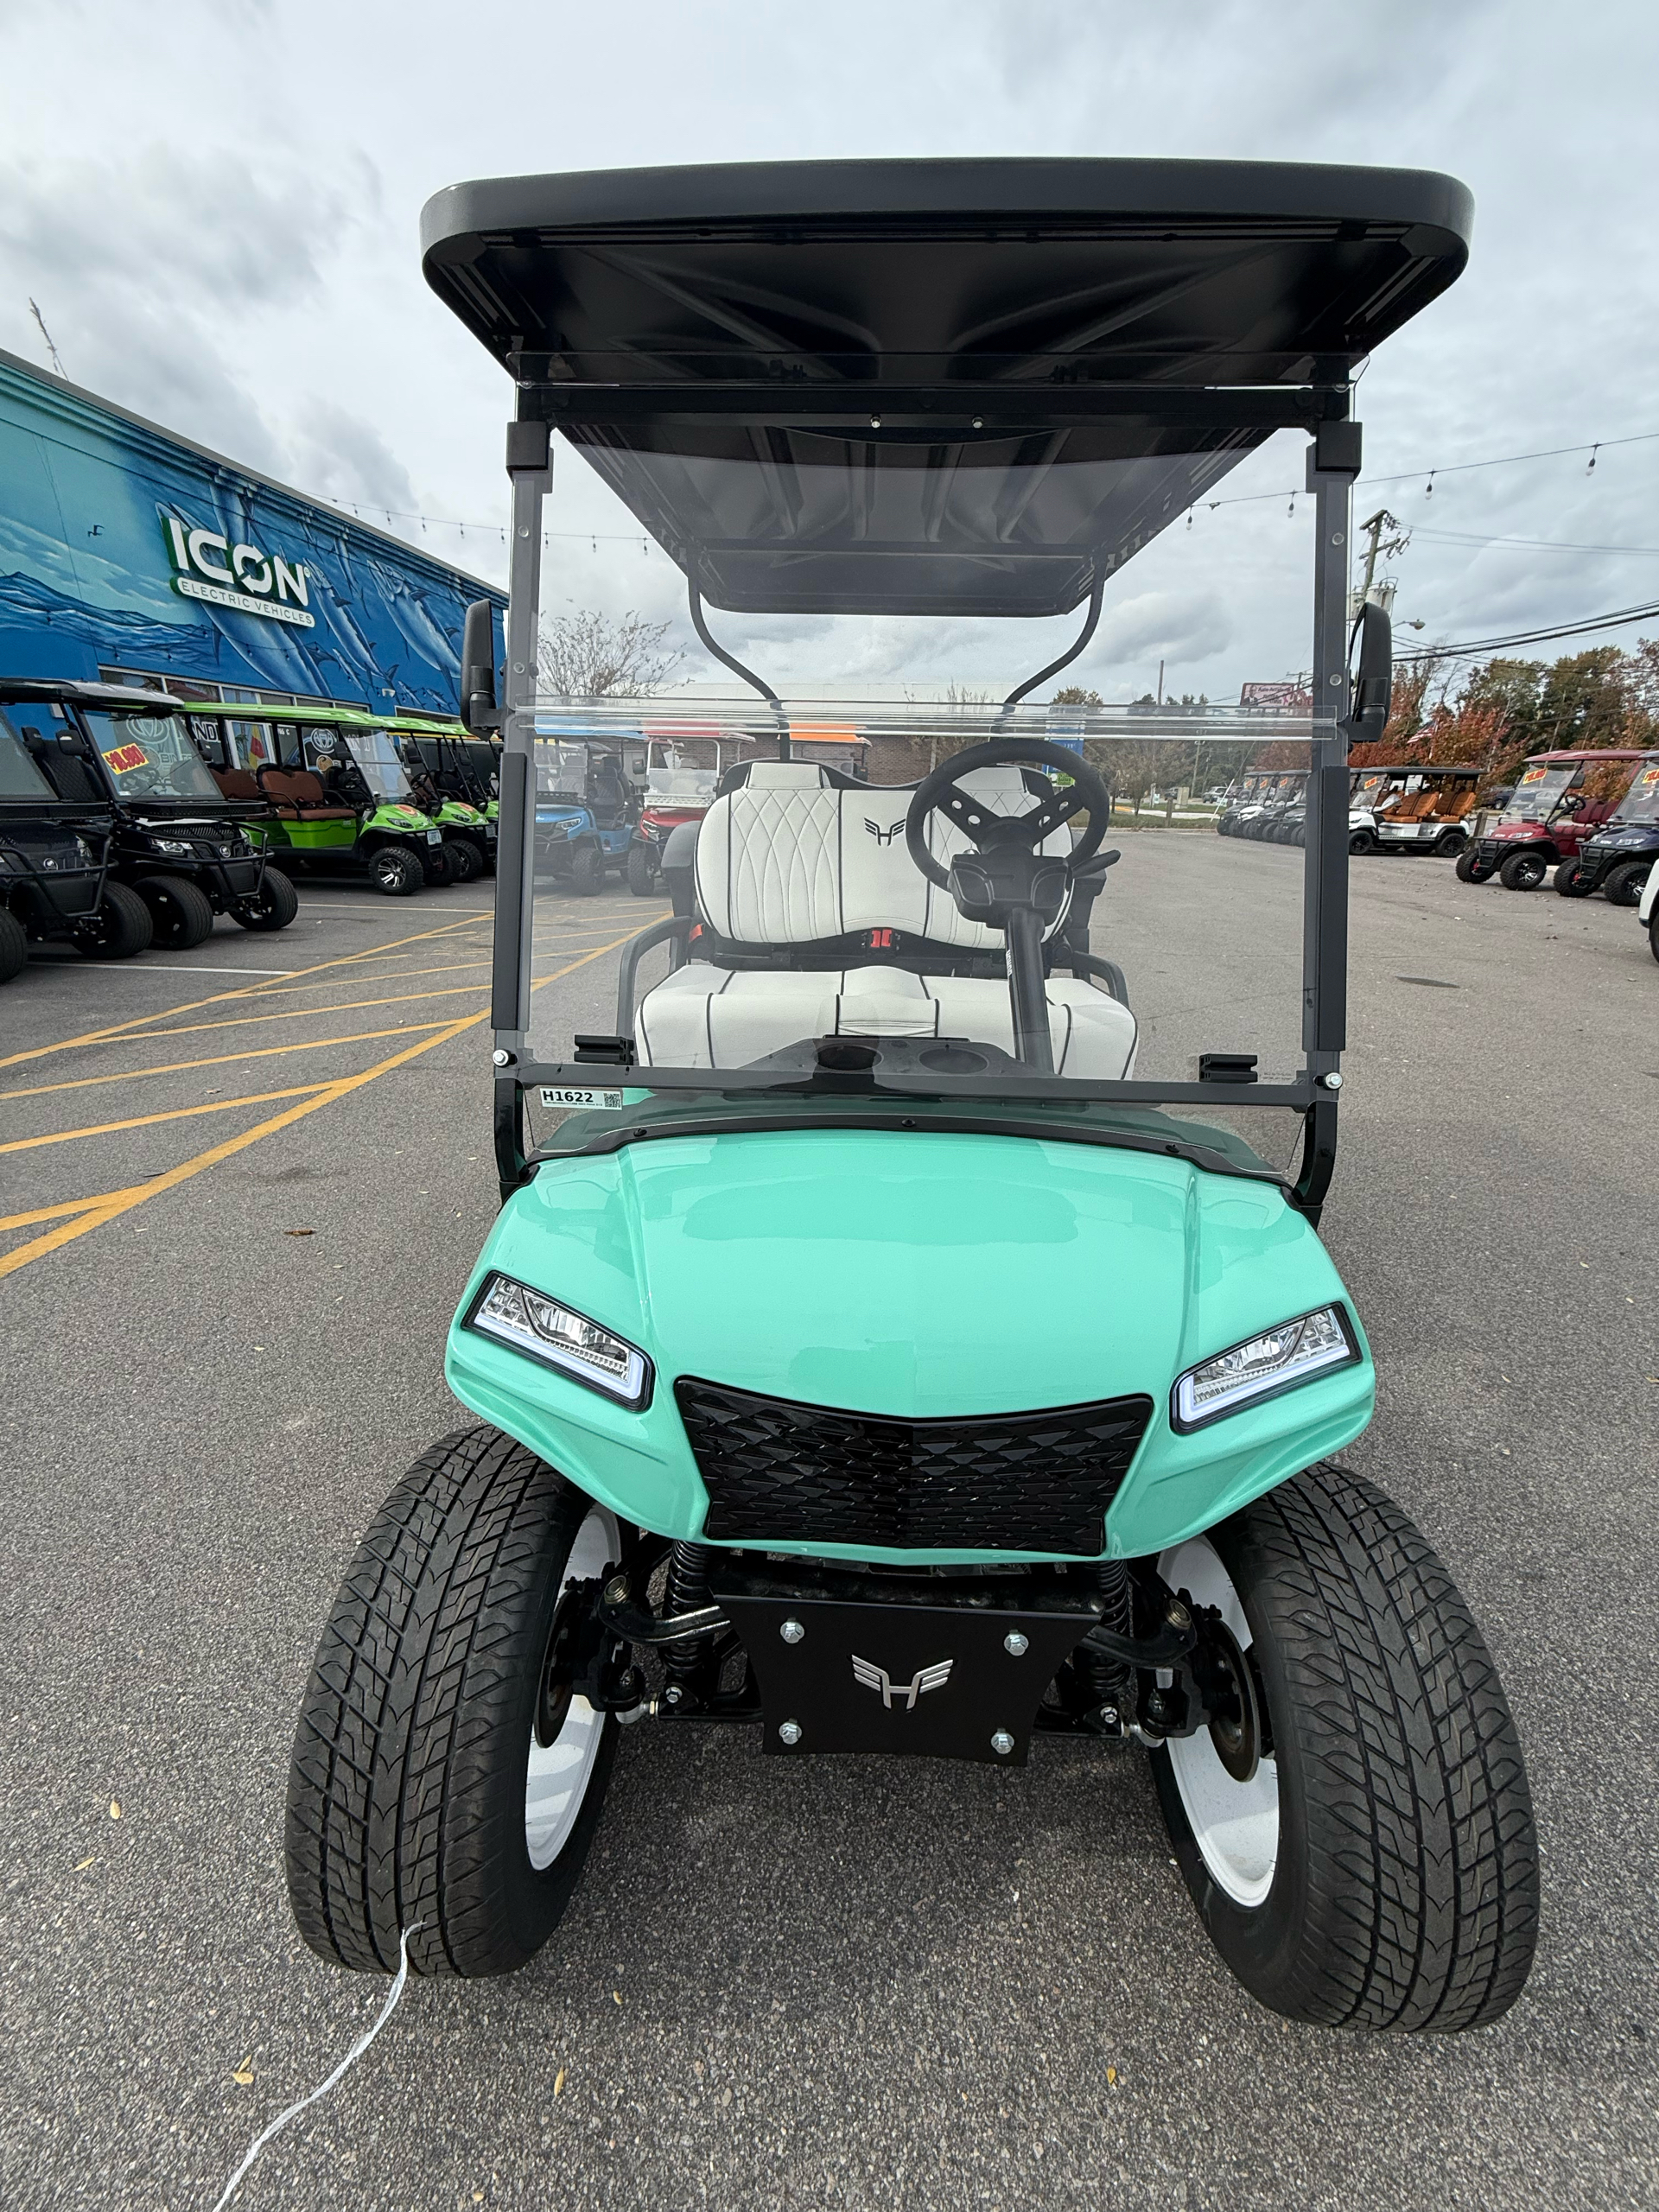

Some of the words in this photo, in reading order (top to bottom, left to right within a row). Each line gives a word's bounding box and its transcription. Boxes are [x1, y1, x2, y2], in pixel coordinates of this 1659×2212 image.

[168, 518, 308, 607] ICON
[181, 581, 251, 608] ELECTRIC
[254, 601, 313, 625] VEHICLES
[543, 1090, 594, 1103] H1622
